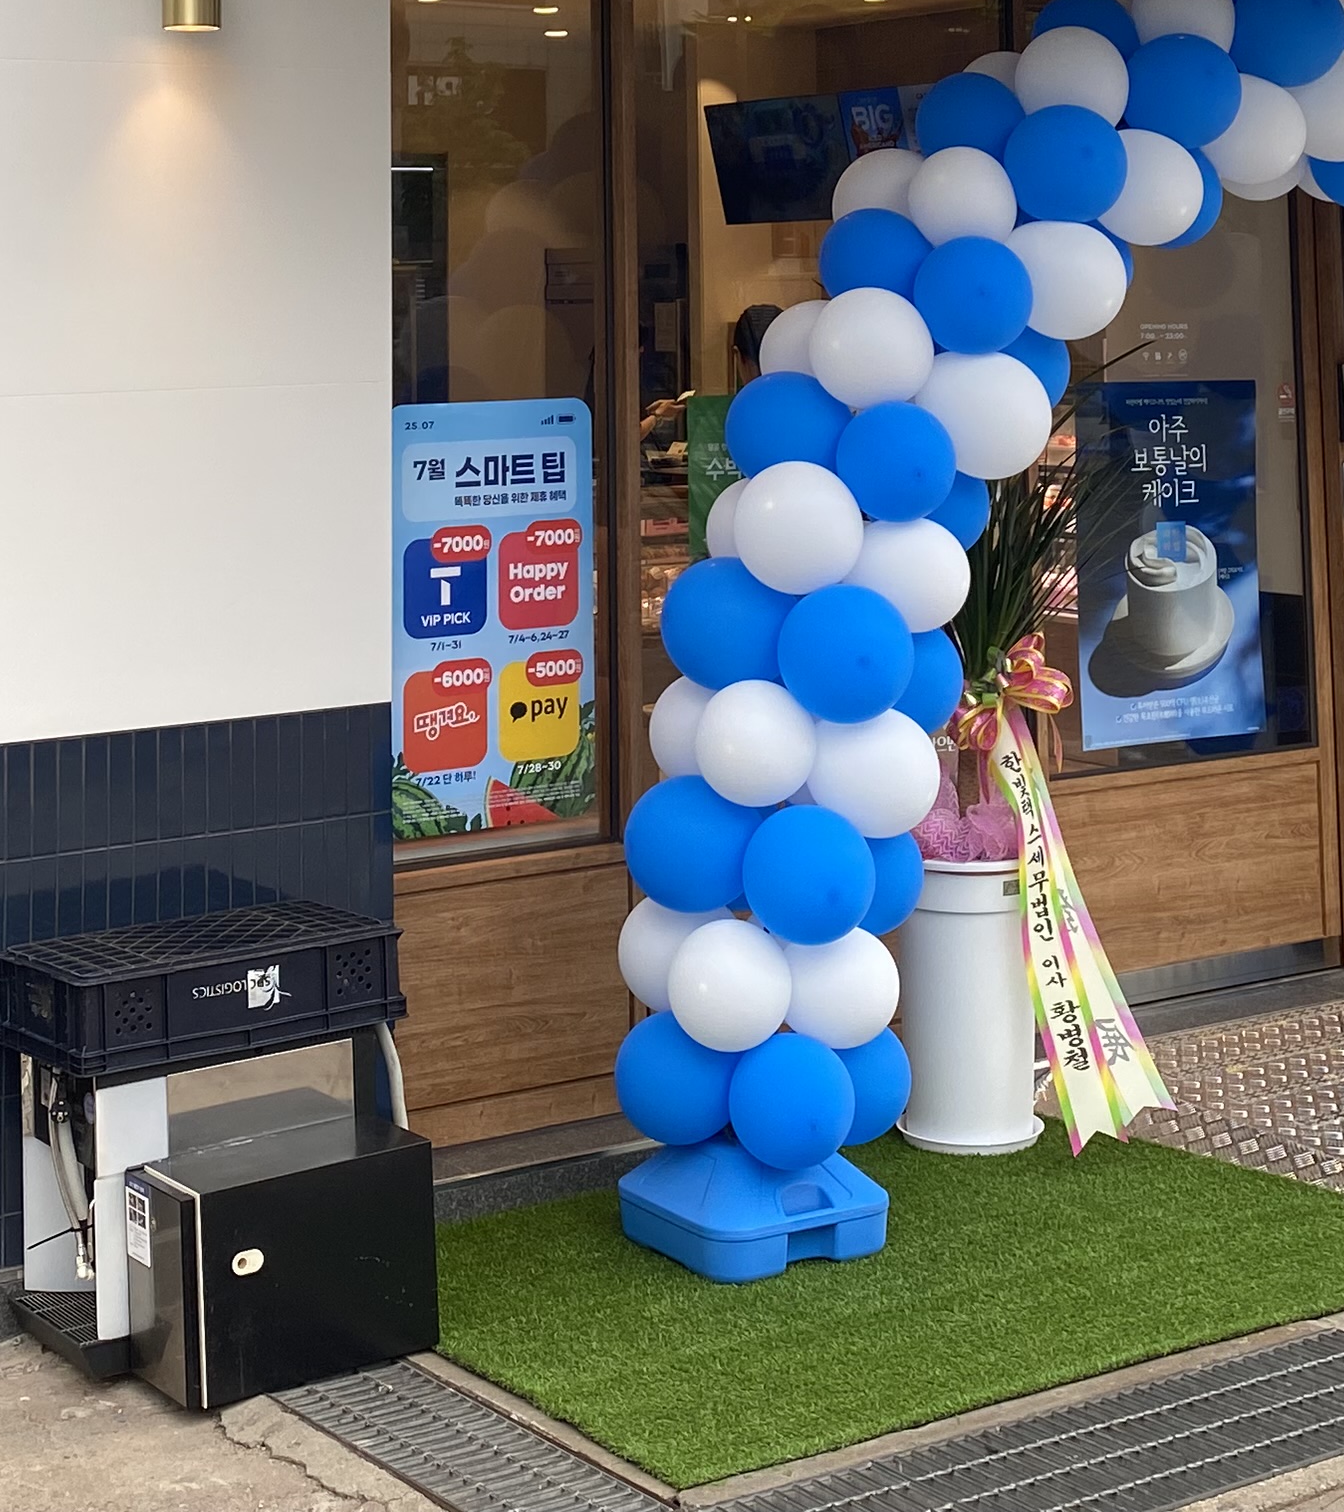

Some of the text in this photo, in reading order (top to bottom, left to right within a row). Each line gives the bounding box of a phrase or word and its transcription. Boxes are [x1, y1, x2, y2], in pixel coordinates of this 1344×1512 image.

[851, 102, 895, 131] BIG
[1148, 413, 1190, 444] 아주
[412, 451, 566, 489] 7월 스마트 팁
[1130, 443, 1207, 477] 보통날의
[482, 492, 510, 507] 당신을
[511, 491, 529, 505] 위한
[530, 490, 548, 503] 제휴
[549, 489, 568, 502] 혜택
[1141, 477, 1200, 508] 케이크
[429, 565, 462, 606] T
[508, 561, 569, 582] Happy
[509, 583, 567, 603] Order
[420, 611, 472, 628] VIP PICK
[413, 701, 481, 741] 땡겨요
[531, 696, 569, 723] pay
[415, 775, 441, 787] 7/22
[442, 774, 453, 786] 단
[191, 979, 247, 1000] LOGISTICS
